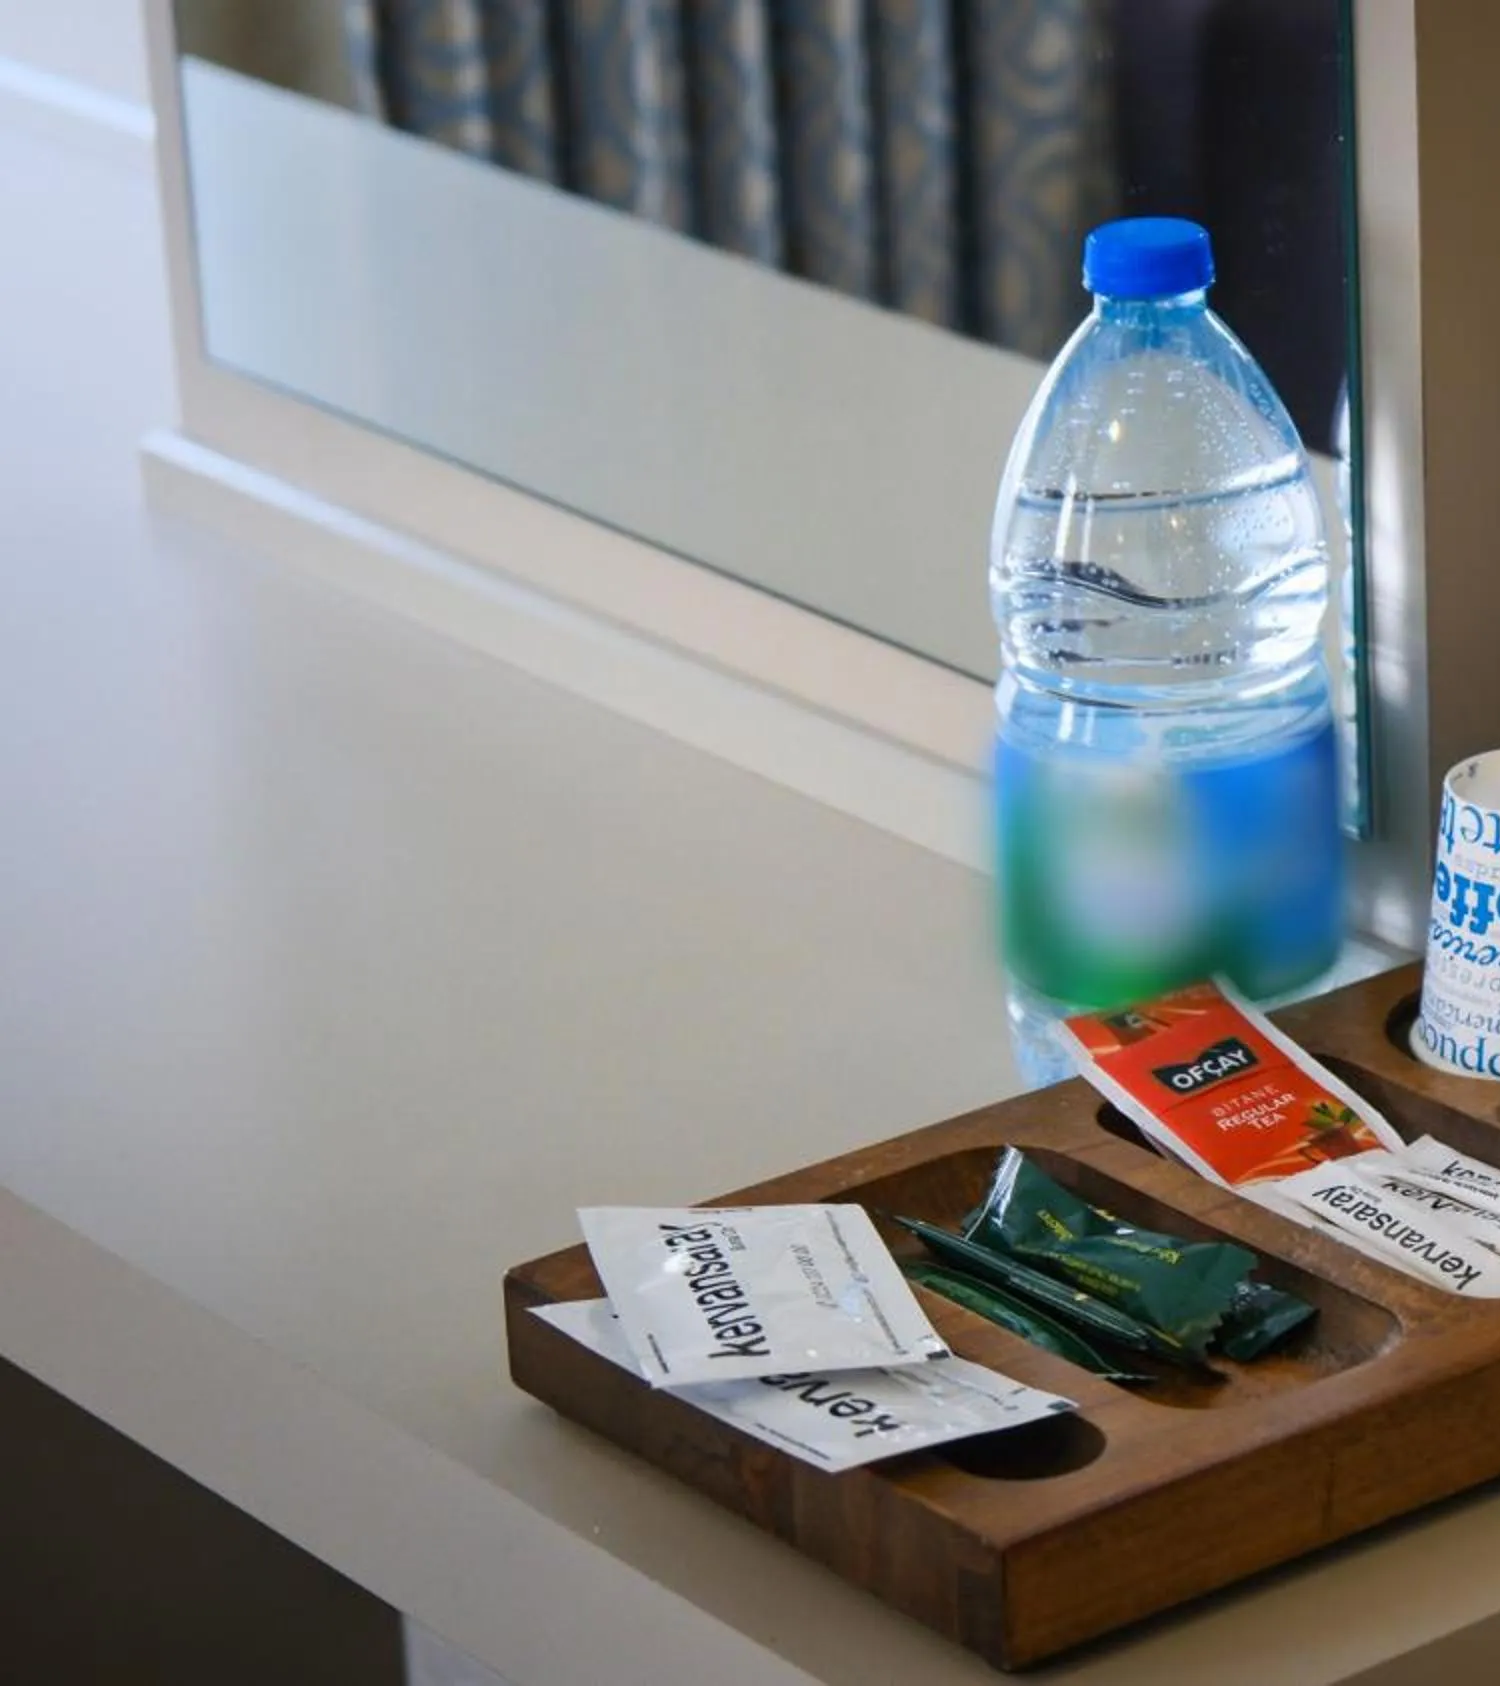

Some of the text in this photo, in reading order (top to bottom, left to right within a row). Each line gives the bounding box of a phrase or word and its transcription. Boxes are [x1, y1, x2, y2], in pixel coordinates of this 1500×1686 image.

[1171, 1047, 1252, 1090] OFÇAY
[1215, 1092, 1297, 1133] REGULAR
[1247, 1112, 1286, 1131] TEA
[1310, 1184, 1483, 1291] kervansaray
